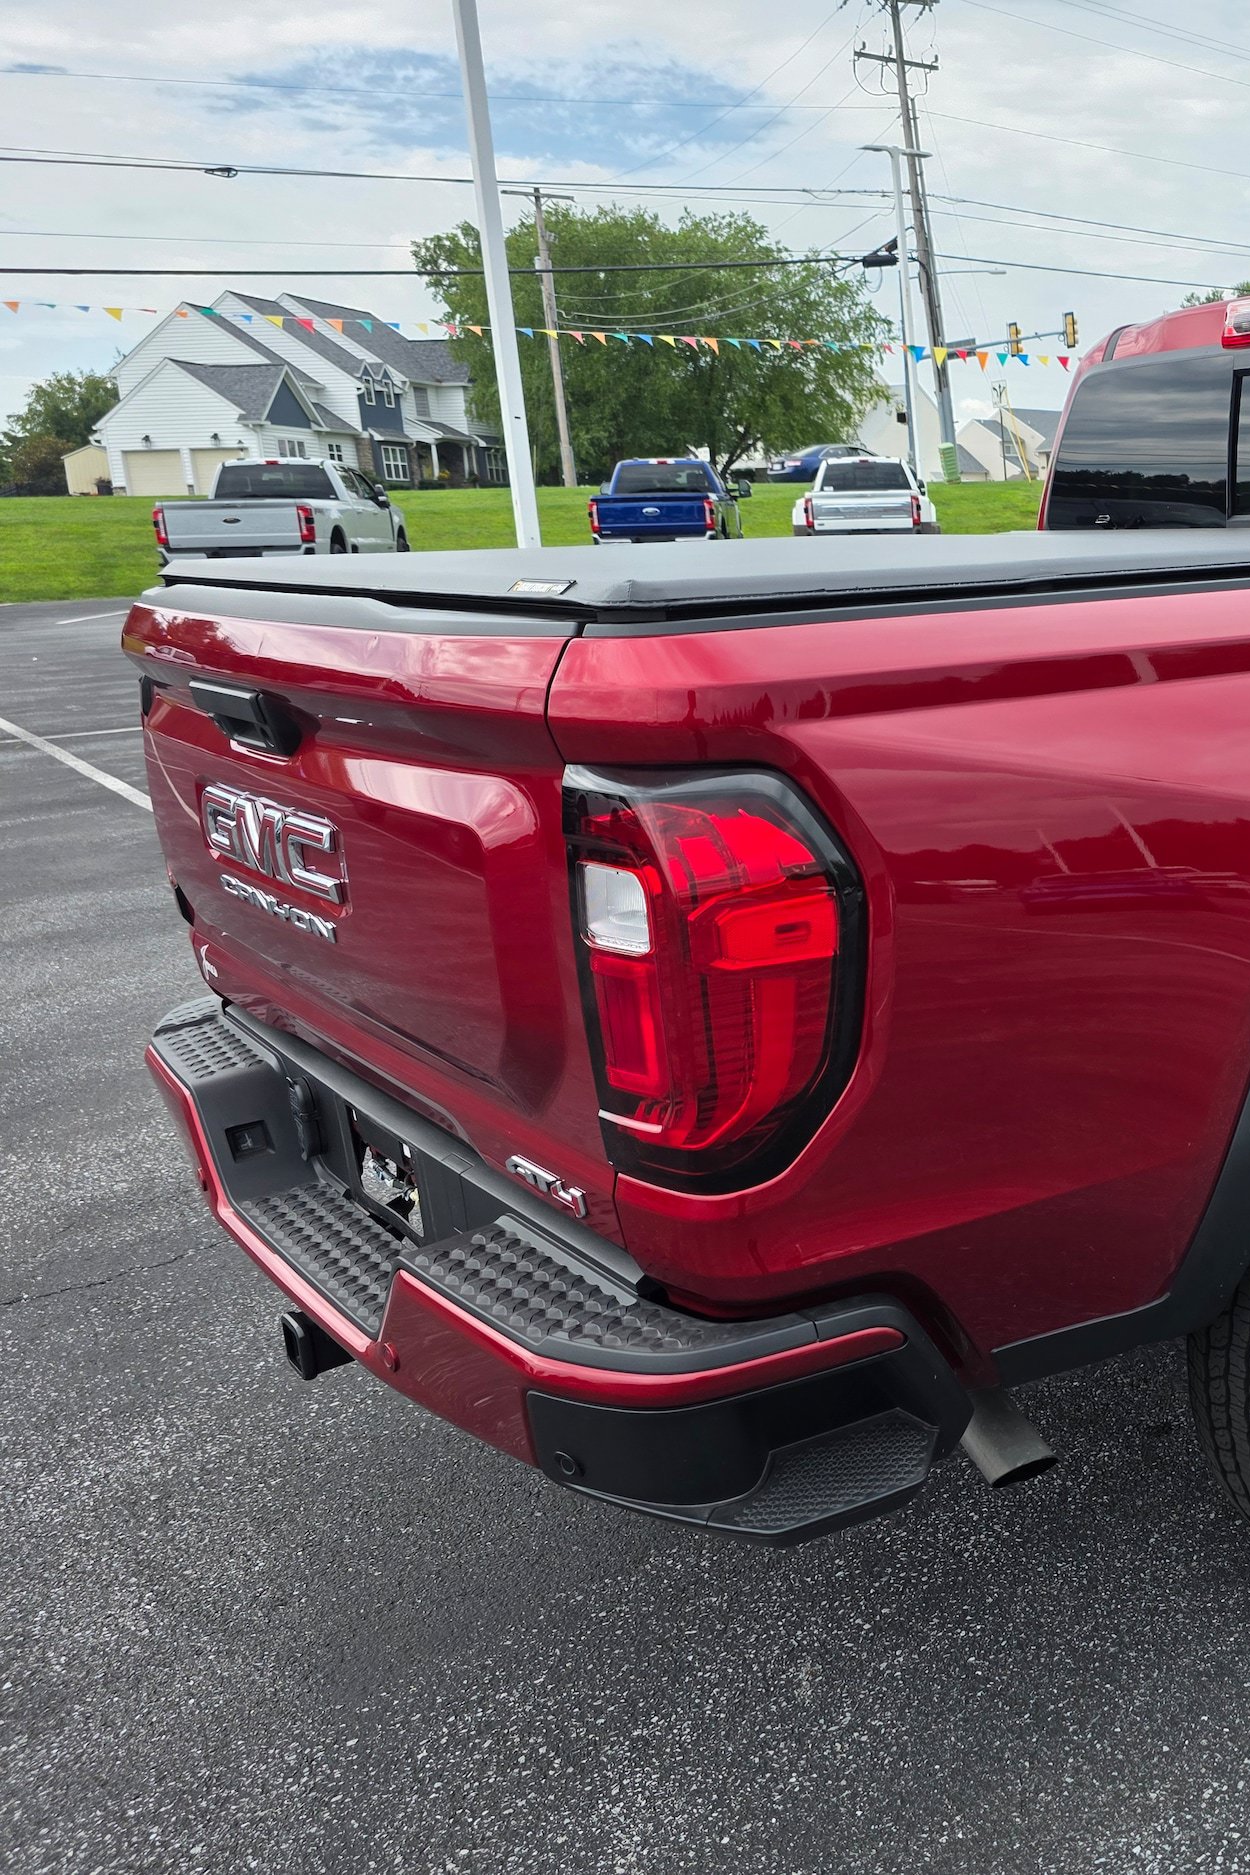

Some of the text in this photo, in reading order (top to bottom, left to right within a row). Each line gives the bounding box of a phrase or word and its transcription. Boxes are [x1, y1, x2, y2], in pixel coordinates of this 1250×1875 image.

[202, 784, 344, 904] GMC
[220, 874, 337, 943] CANYON
[505, 1155, 587, 1218] AT4
